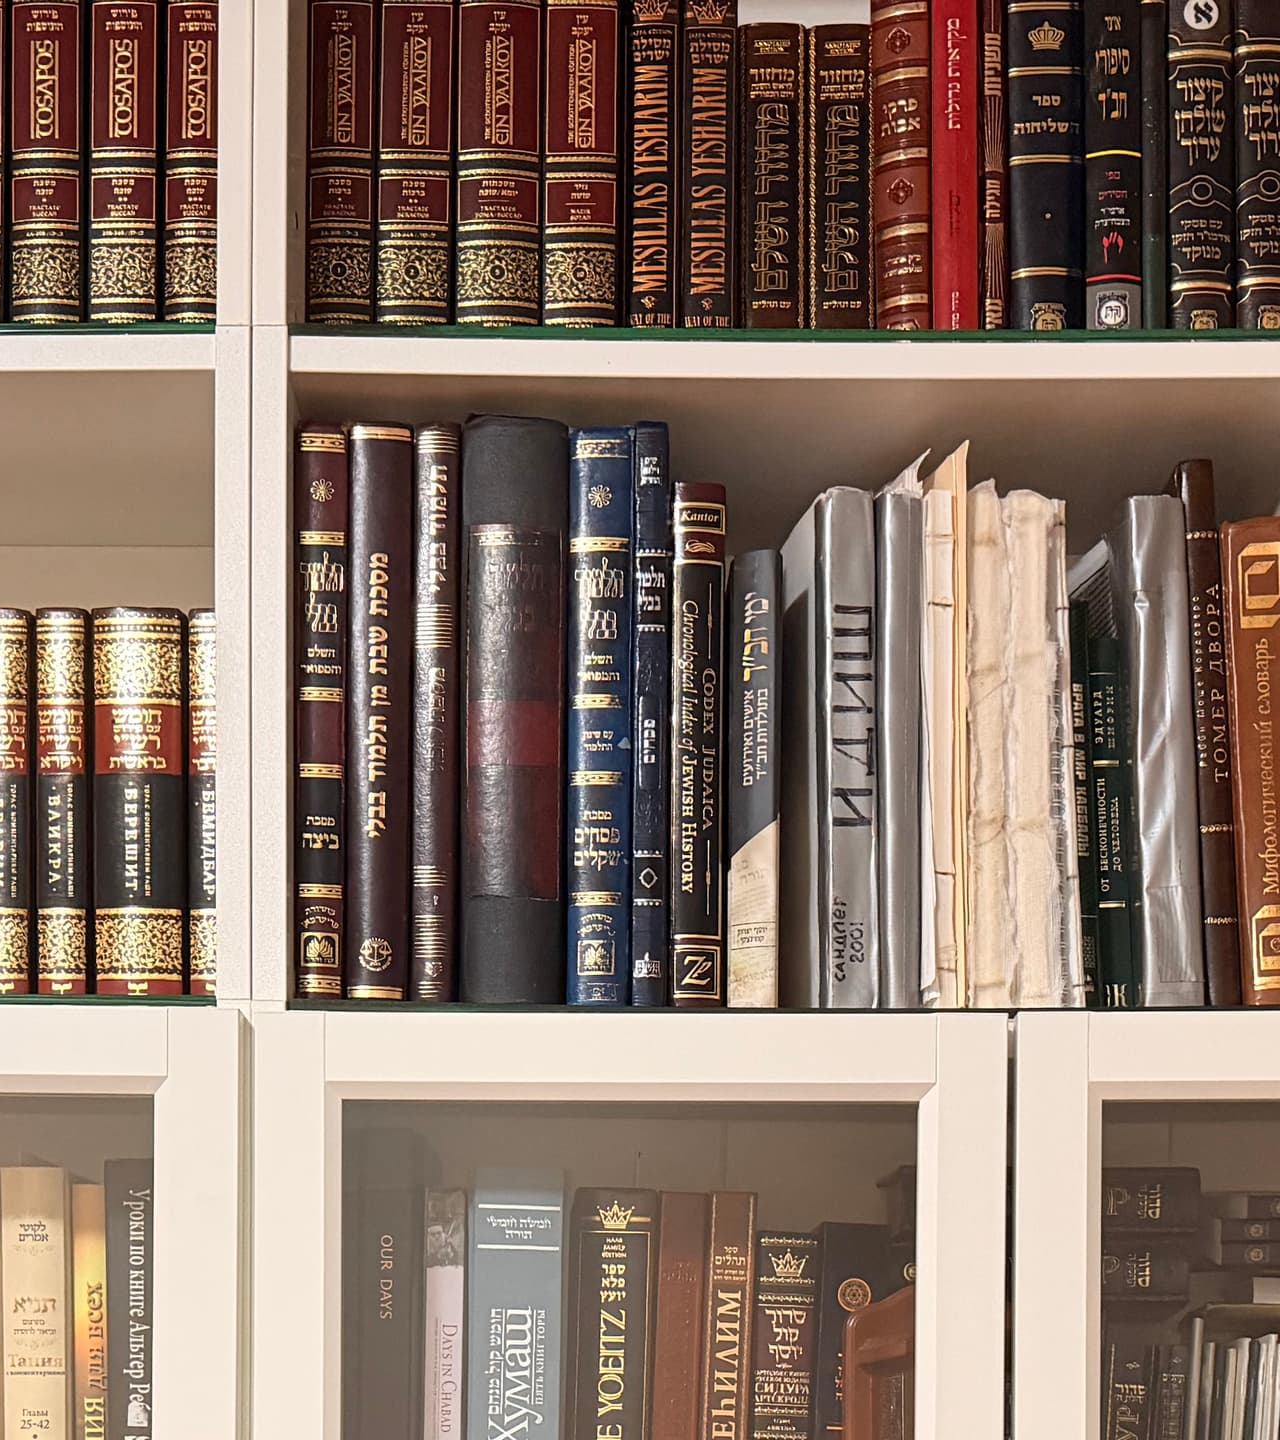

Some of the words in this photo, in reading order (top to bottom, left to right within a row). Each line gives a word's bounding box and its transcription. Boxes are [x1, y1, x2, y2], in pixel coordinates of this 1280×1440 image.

[635, 65, 668, 182] YESHARIM
[1032, 93, 1061, 107] ספר
[633, 183, 668, 295] MESILLAS
[681, 511, 719, 523] Kantor
[369, 553, 389, 616] מסכת
[370, 626, 388, 675] שבת
[682, 600, 698, 685] Chronological
[1256, 637, 1272, 715] словарь
[369, 685, 390, 705] מן
[683, 690, 694, 727] Index
[702, 668, 716, 735] CODEX
[832, 604, 873, 827] ИДИШ
[368, 714, 389, 783] תלמוד
[682, 732, 695, 747] of
[368, 790, 388, 839] בבלי
[683, 750, 694, 816] JEWISH
[702, 748, 715, 831] JUDAICA
[1257, 722, 1280, 896] Мифологический
[124, 786, 138, 892] БЕРЕШИТ
[682, 825, 695, 893] HISTORY
[599, 1310, 625, 1418] YOEITZ
[20, 1419, 50, 1430] 25-42
